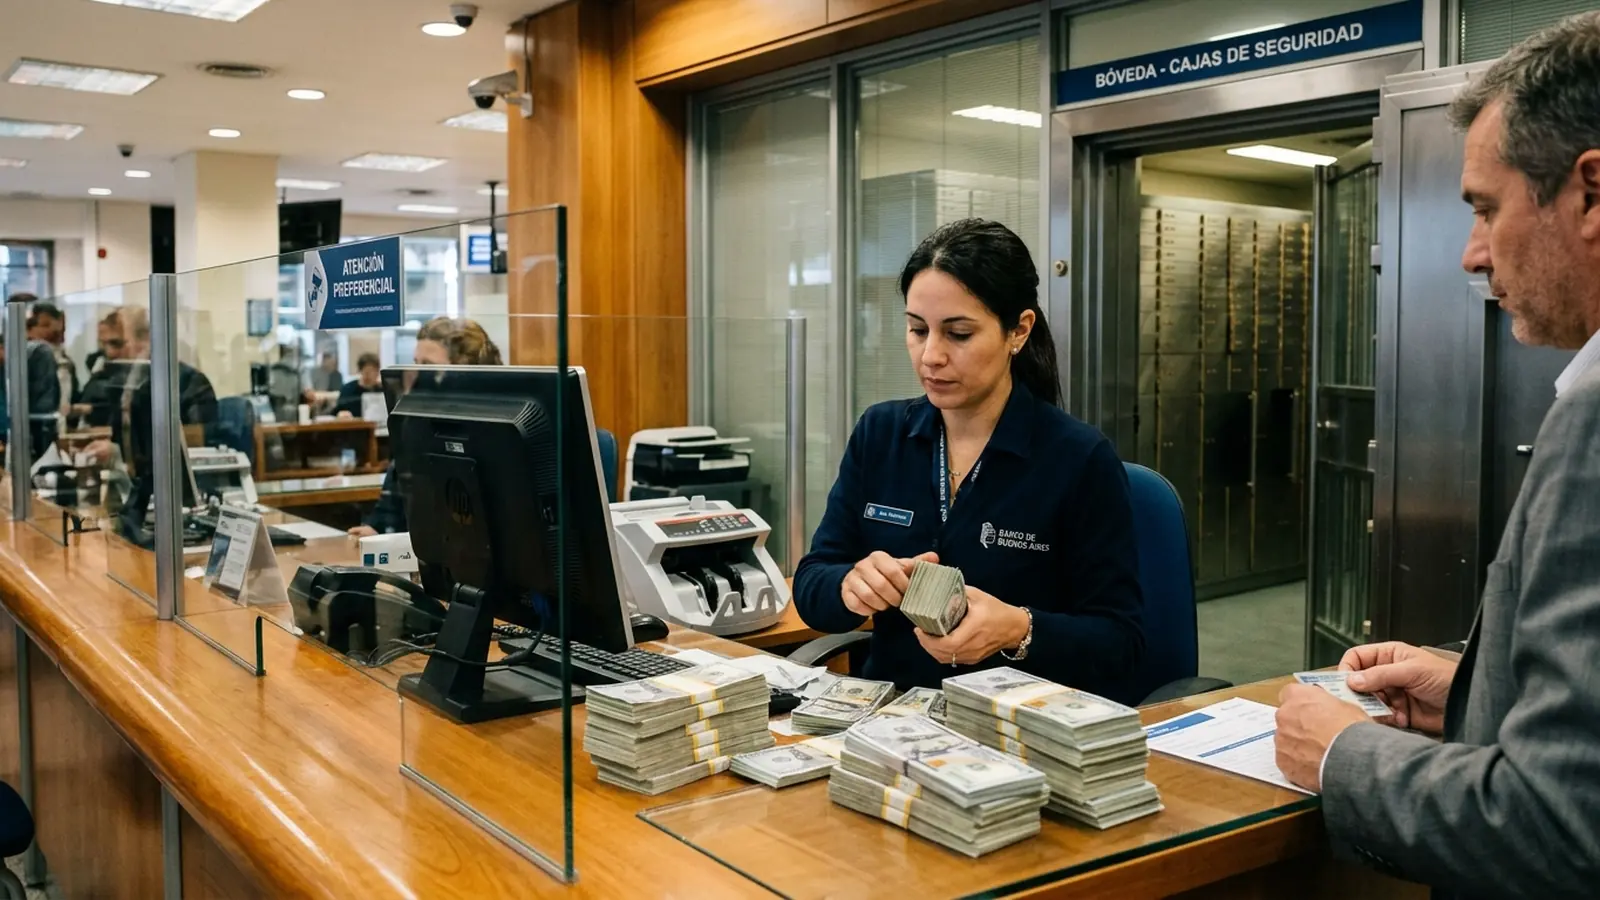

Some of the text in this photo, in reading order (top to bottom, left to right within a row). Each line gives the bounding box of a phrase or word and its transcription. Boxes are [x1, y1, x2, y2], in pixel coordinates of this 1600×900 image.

[1096, 64, 1157, 88] BÓVEDA
[1169, 50, 1222, 74] CAJAS
[1227, 44, 1250, 64] DE
[1254, 22, 1364, 58] SEGURIDAD
[1026, 533, 1036, 542] DE
